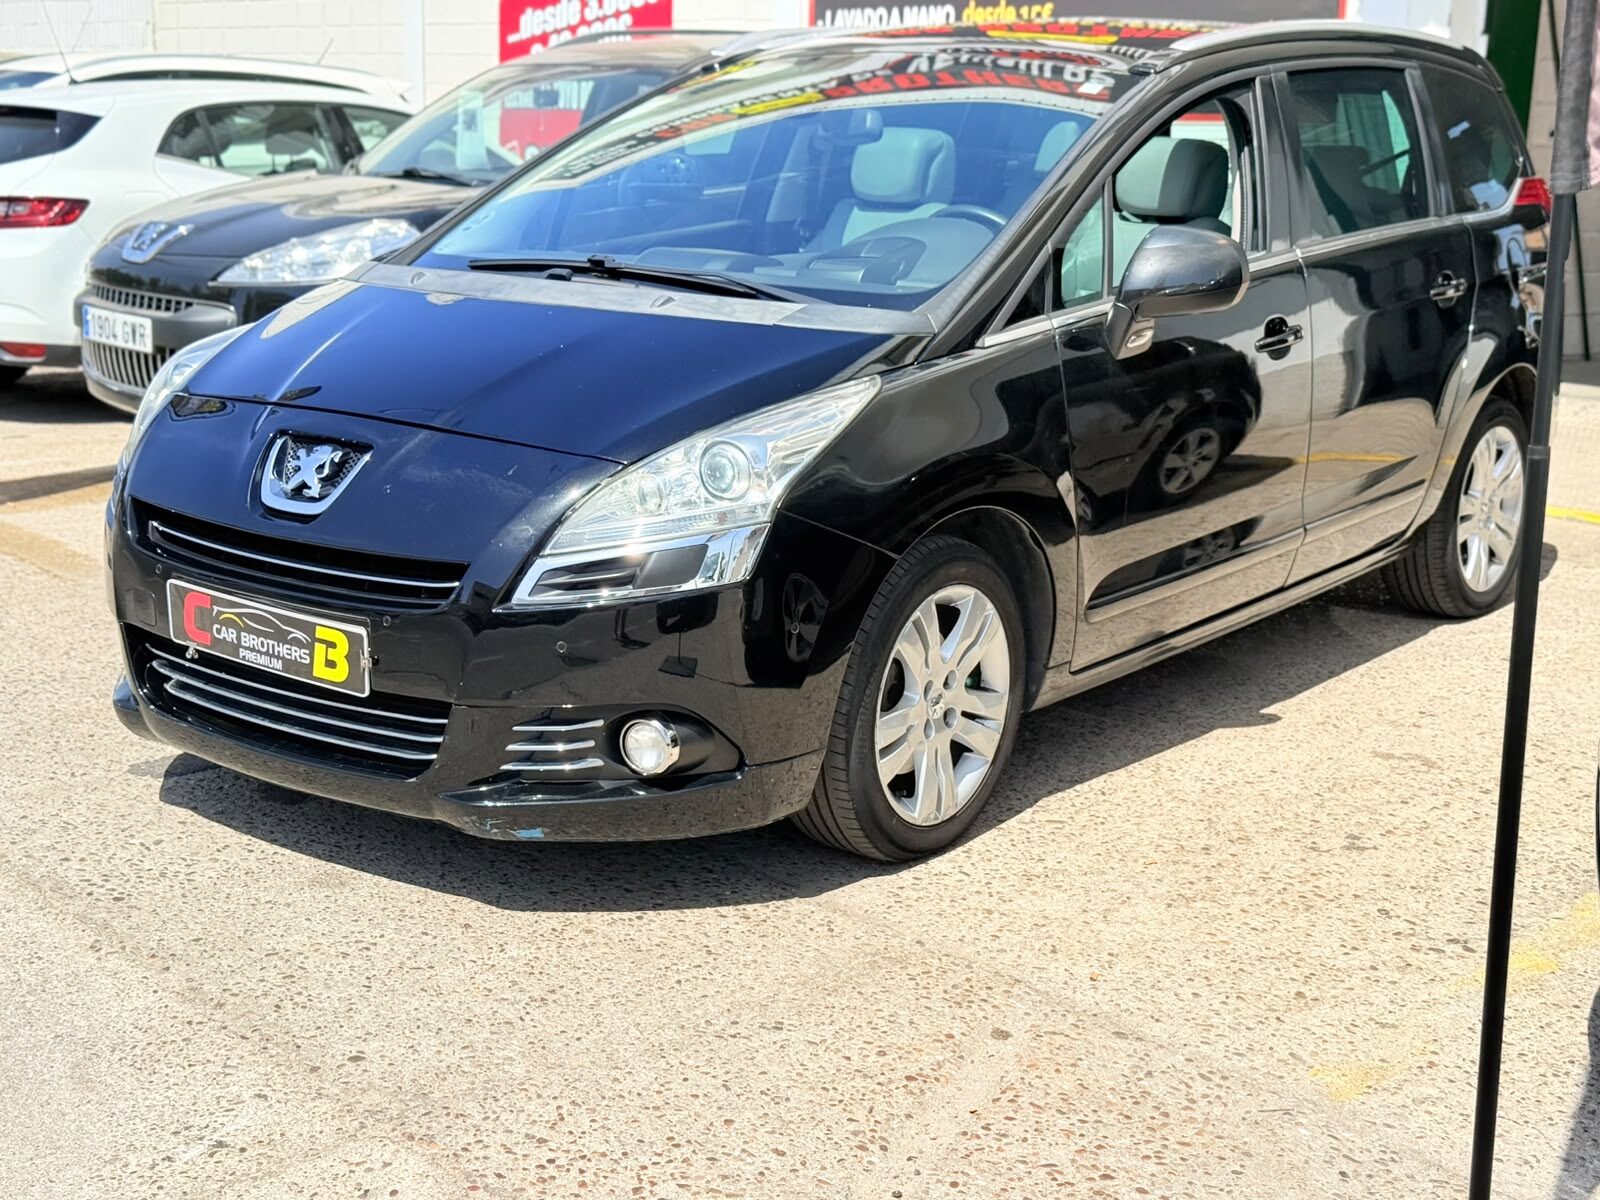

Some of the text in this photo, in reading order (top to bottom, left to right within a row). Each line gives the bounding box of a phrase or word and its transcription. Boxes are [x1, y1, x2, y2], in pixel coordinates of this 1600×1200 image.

[92, 312, 147, 347] 1904 GWR
[212, 623, 311, 665] CAR BROTHERS
[239, 647, 283, 671] PREMIUM
